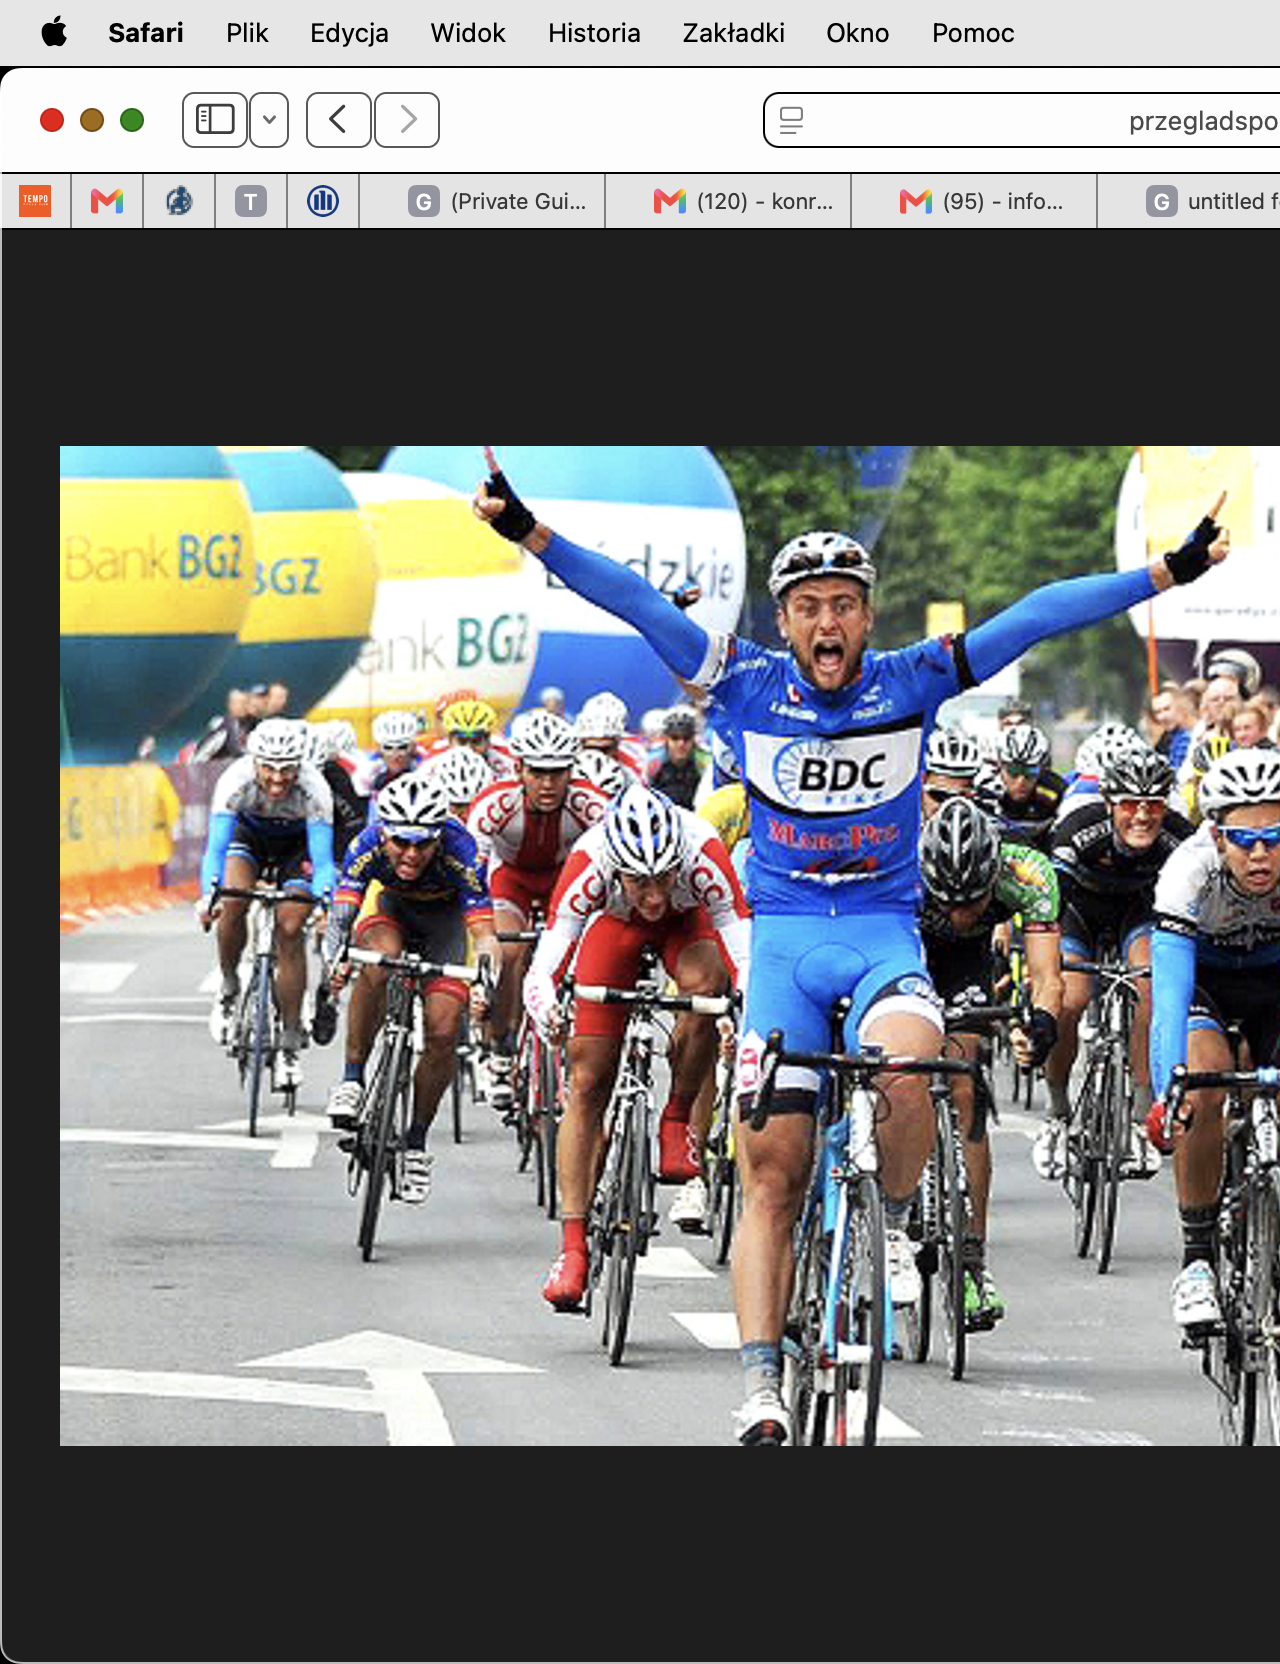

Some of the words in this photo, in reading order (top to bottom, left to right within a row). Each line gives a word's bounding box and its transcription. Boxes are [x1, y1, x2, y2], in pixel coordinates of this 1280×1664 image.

[109, 21, 183, 43] Safari
[228, 22, 269, 42] Plik
[312, 22, 388, 47] Edycja
[431, 22, 506, 42] Widok
[550, 22, 640, 42] Historia
[683, 22, 784, 42] Zakładki
[827, 22, 889, 43] Okno
[934, 23, 1014, 42] Pomoc
[23, 194, 49, 203] TEMPO
[452, 192, 528, 214] (Private
[698, 192, 747, 214] (120)
[944, 192, 983, 214] (95)
[1189, 192, 1263, 210] untitled
[66, 533, 170, 582] Bank
[546, 541, 735, 600] dzkie
[353, 618, 446, 676] ank
[799, 752, 886, 791] BDC
